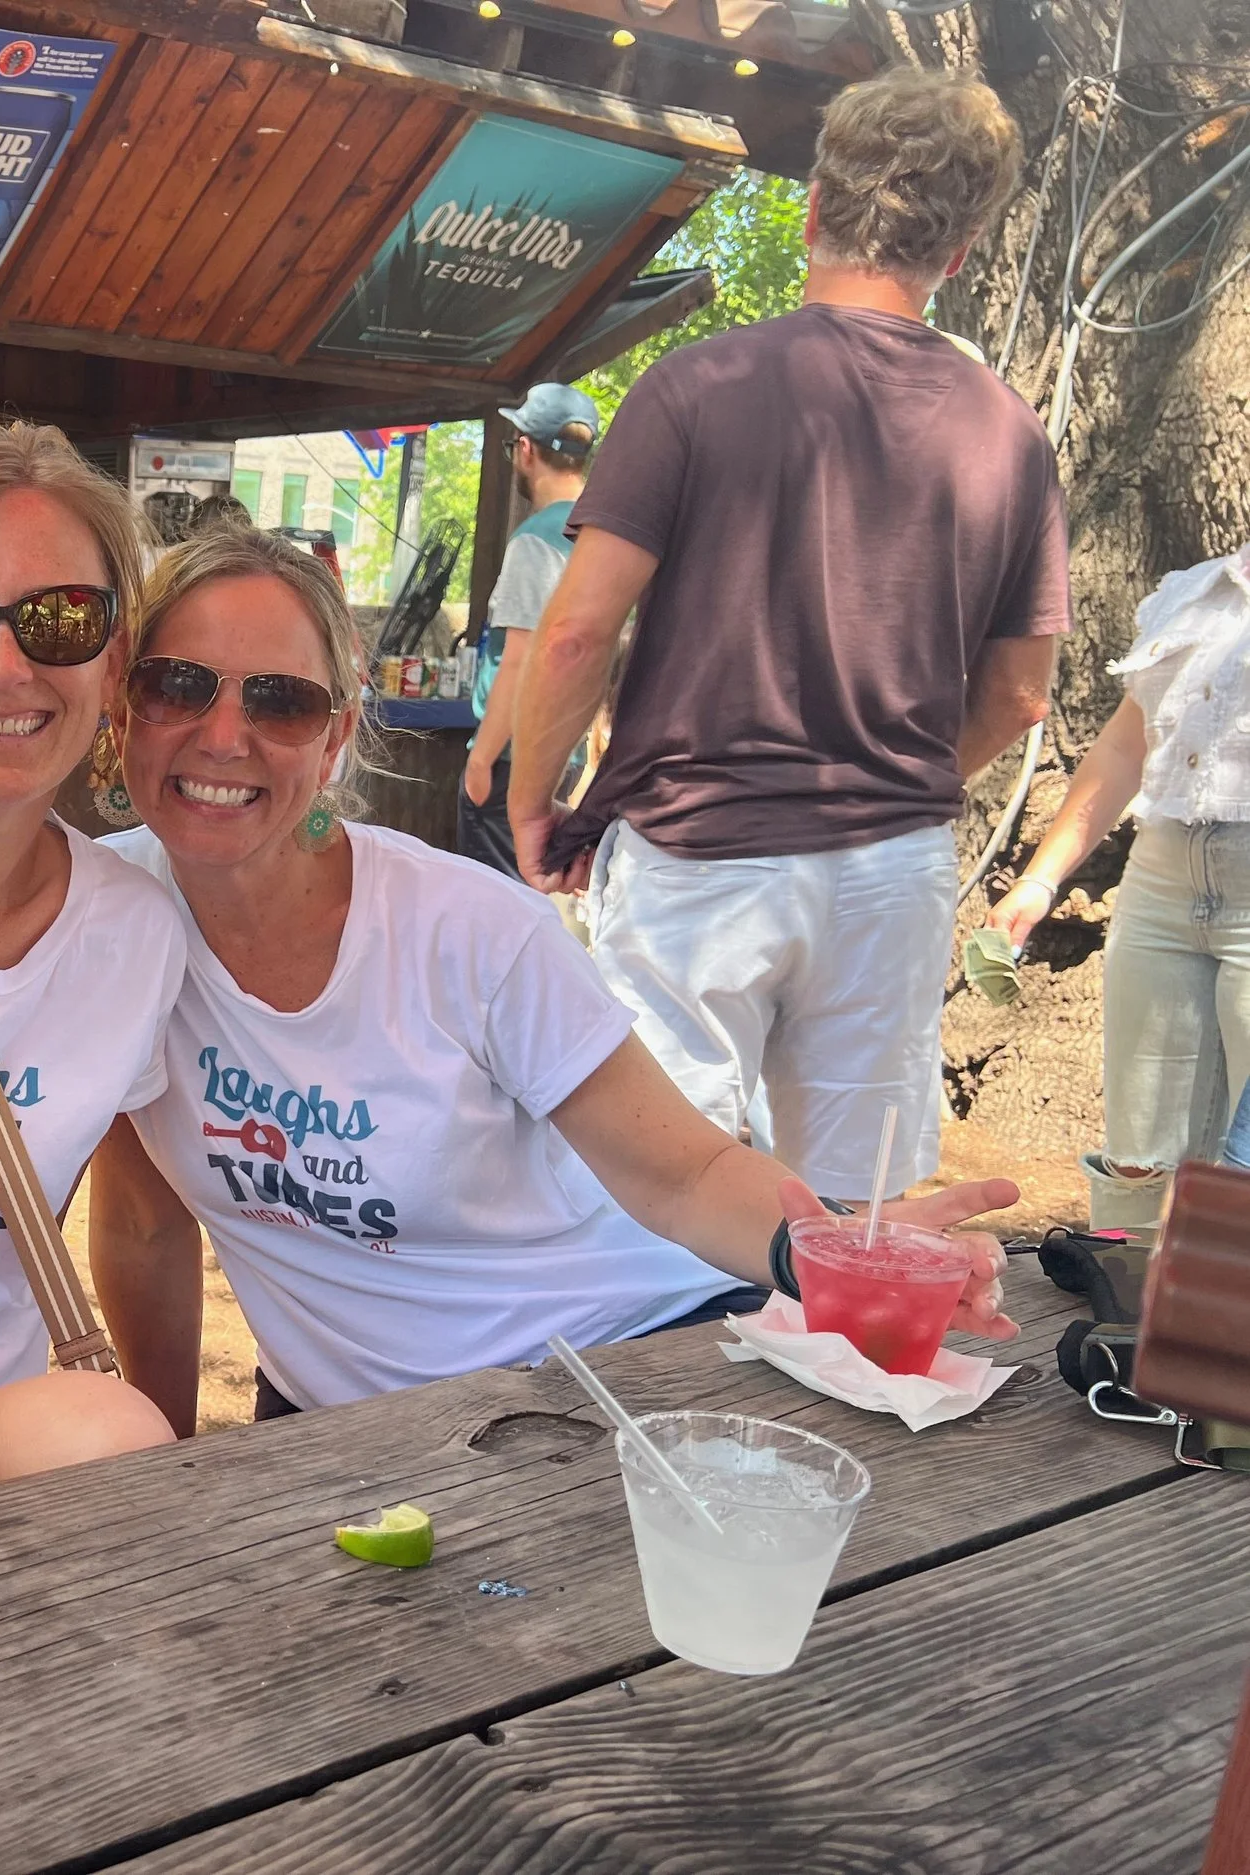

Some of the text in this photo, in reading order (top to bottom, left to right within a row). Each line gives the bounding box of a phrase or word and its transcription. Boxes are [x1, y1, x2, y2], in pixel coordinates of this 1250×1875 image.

[412, 200, 584, 271] Dulce Vida
[423, 260, 525, 291] TEQUILA
[199, 1046, 379, 1149] Laughs
[207, 1153, 398, 1240] TUNES
[302, 1155, 369, 1186] and
